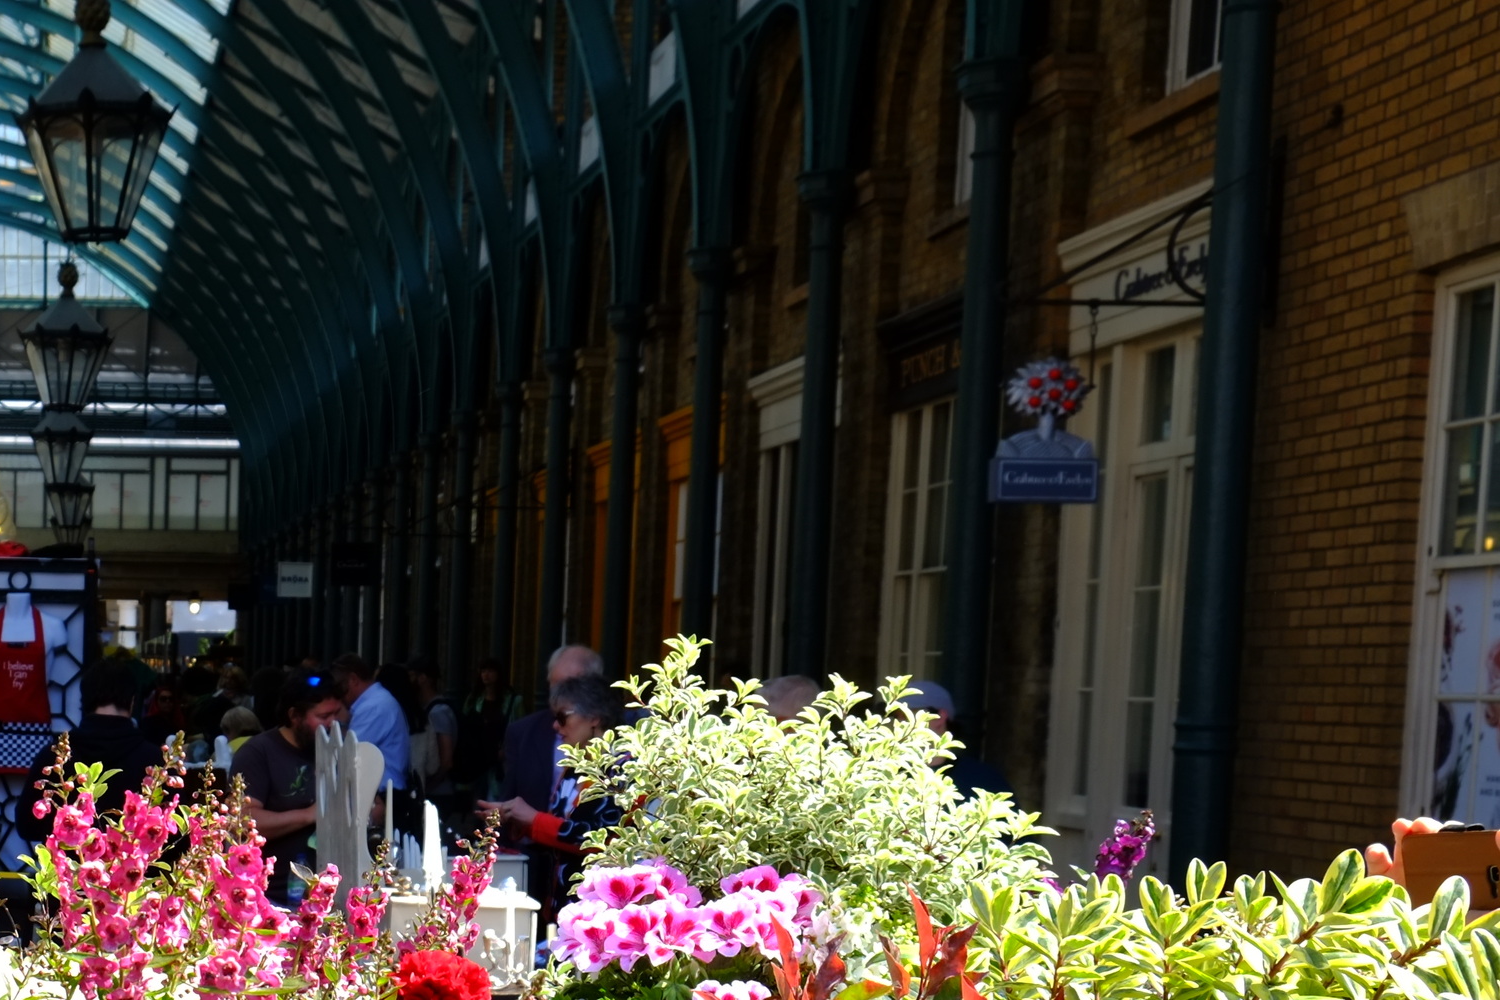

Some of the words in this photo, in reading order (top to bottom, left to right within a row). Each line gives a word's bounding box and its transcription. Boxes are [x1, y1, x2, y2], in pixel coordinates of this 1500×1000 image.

[900, 343, 947, 389] PUNCH
[7, 660, 34, 671] believe
[13, 670, 28, 678] can
